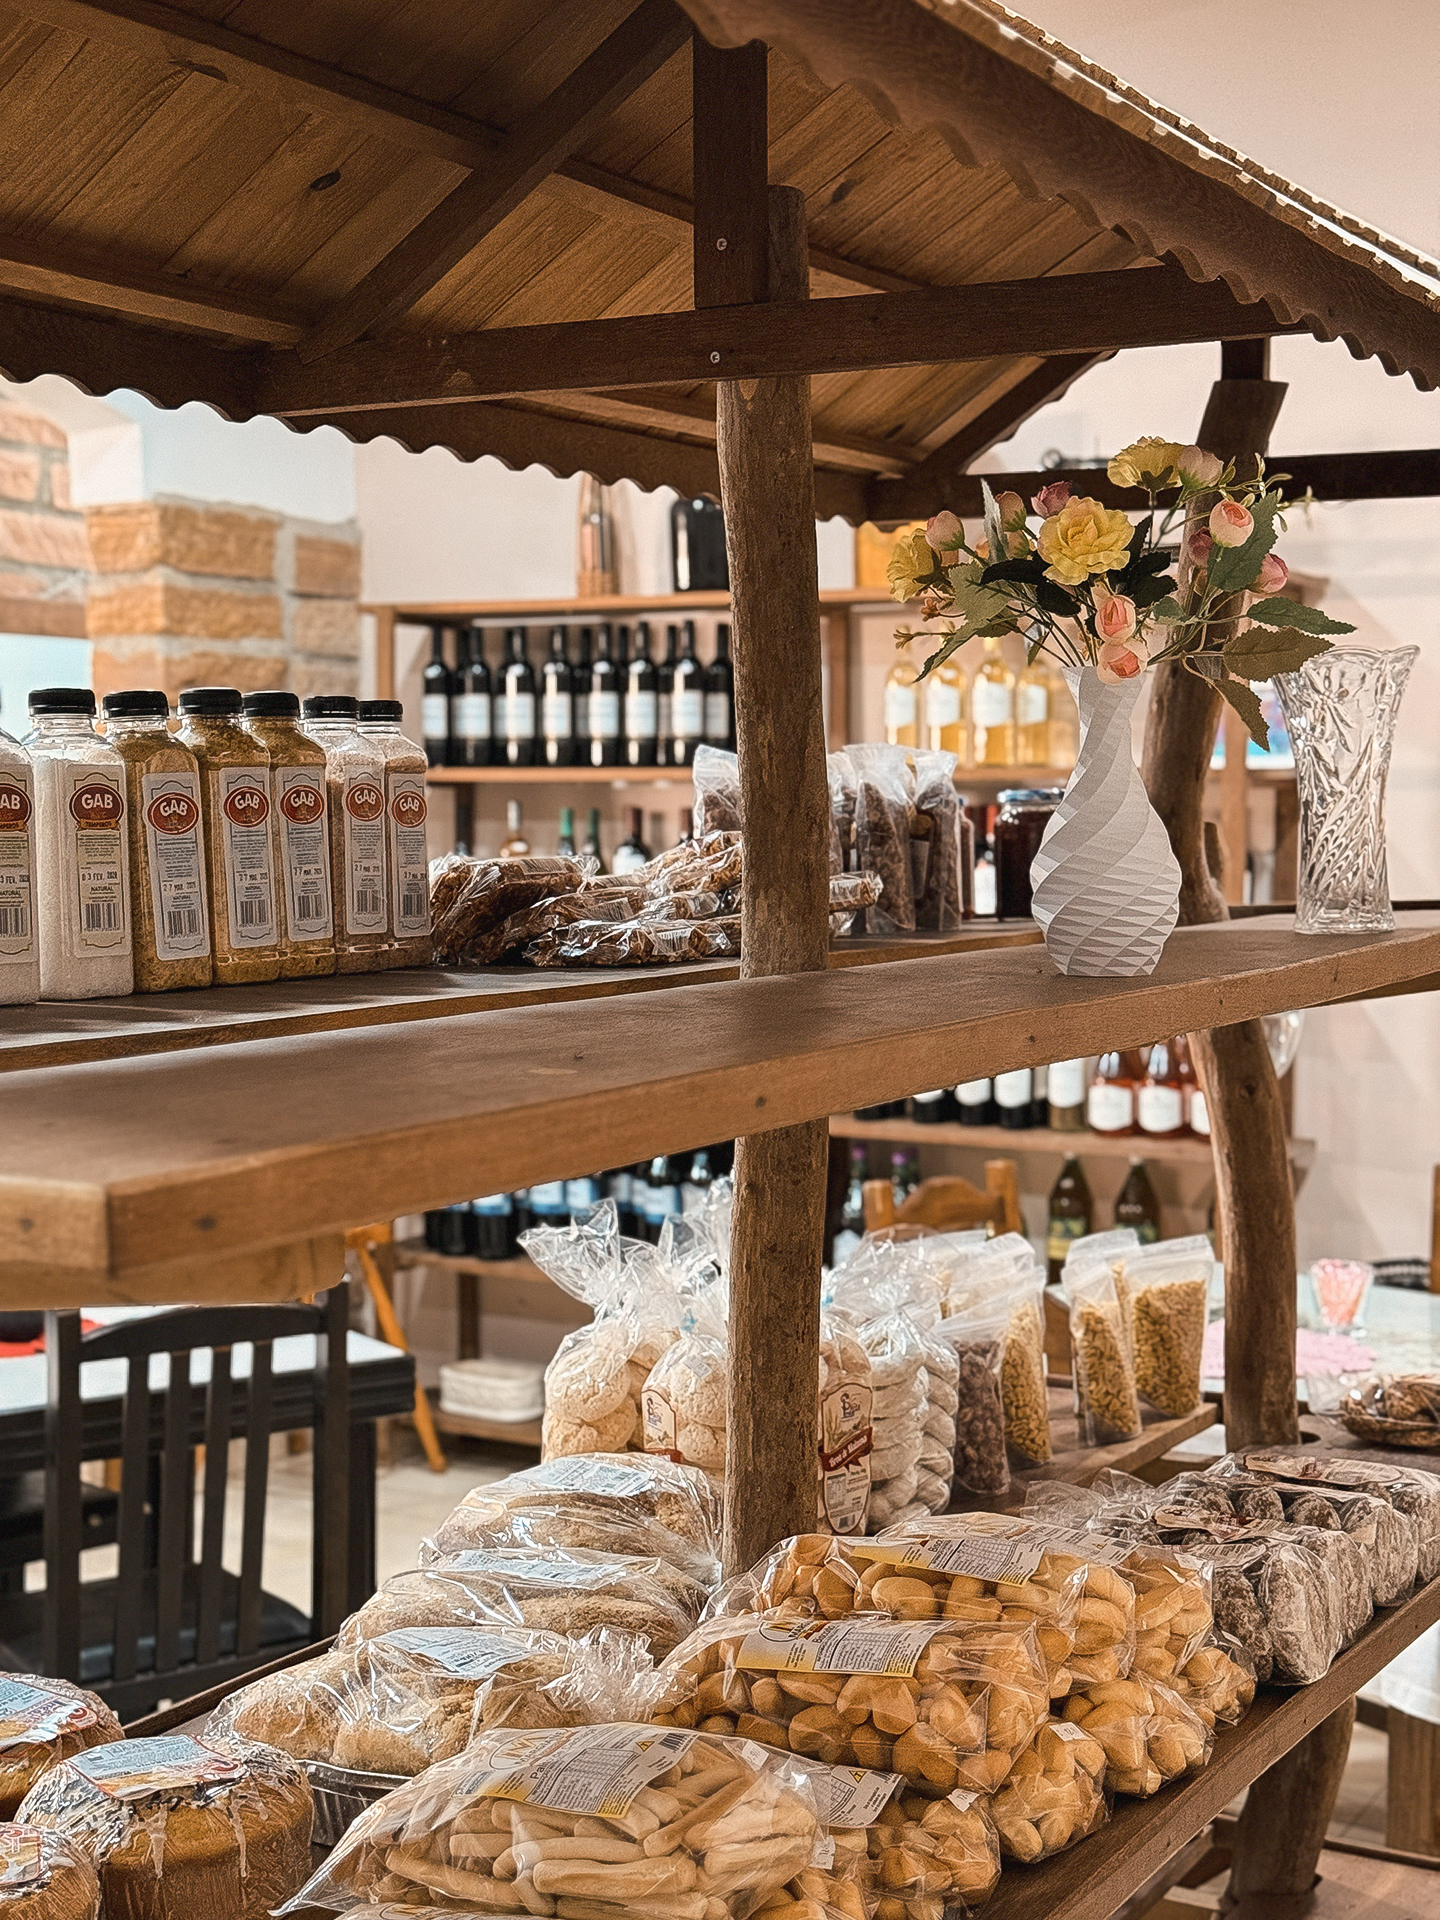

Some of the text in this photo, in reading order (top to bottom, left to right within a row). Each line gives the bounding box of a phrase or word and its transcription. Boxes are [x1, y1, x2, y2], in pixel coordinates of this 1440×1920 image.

[0, 793, 20, 809] AB
[81, 793, 113, 809] GAB
[234, 793, 260, 810] GAB
[291, 791, 315, 807] GAB
[355, 789, 376, 805] GAB
[399, 796, 420, 812] GAB
[160, 799, 188, 817] GAB
